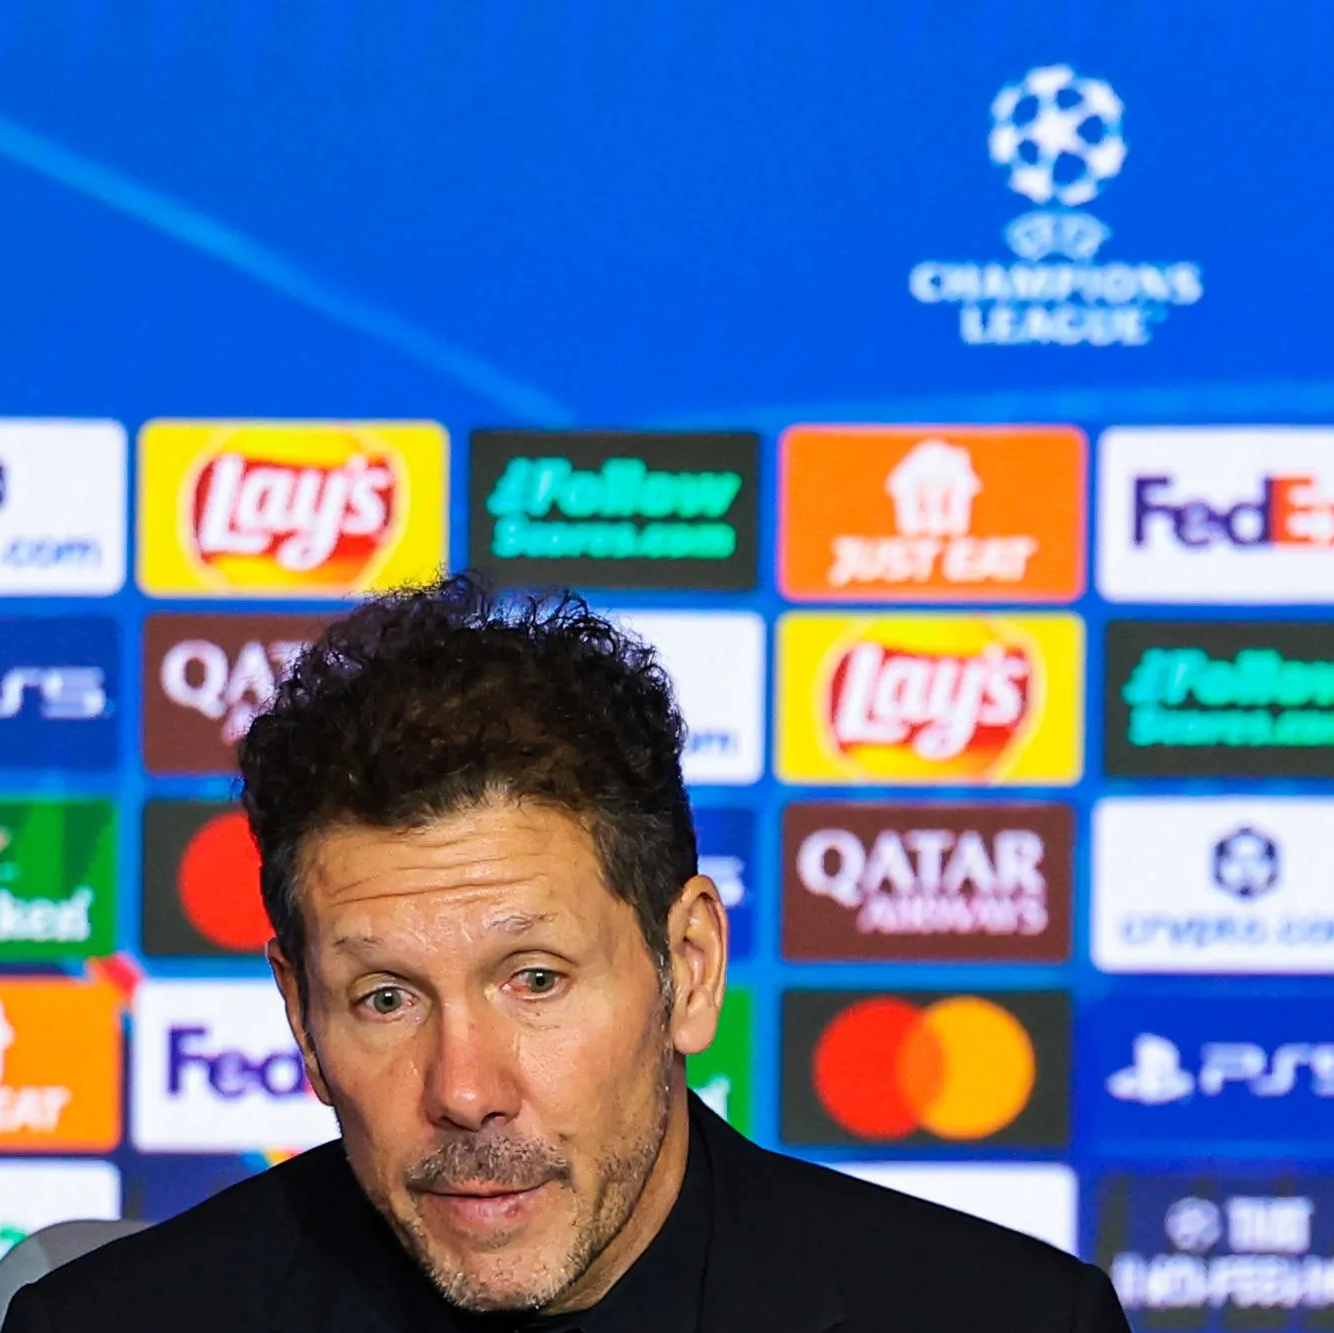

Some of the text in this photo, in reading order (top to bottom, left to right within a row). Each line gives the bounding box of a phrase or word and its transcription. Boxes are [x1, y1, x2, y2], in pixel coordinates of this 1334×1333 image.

[198, 452, 393, 571] Lay's
[828, 535, 1040, 586] JUST EAT
[833, 639, 1030, 760] Lay's
[797, 829, 1044, 906] QATAR
[168, 1025, 308, 1097] Fed
